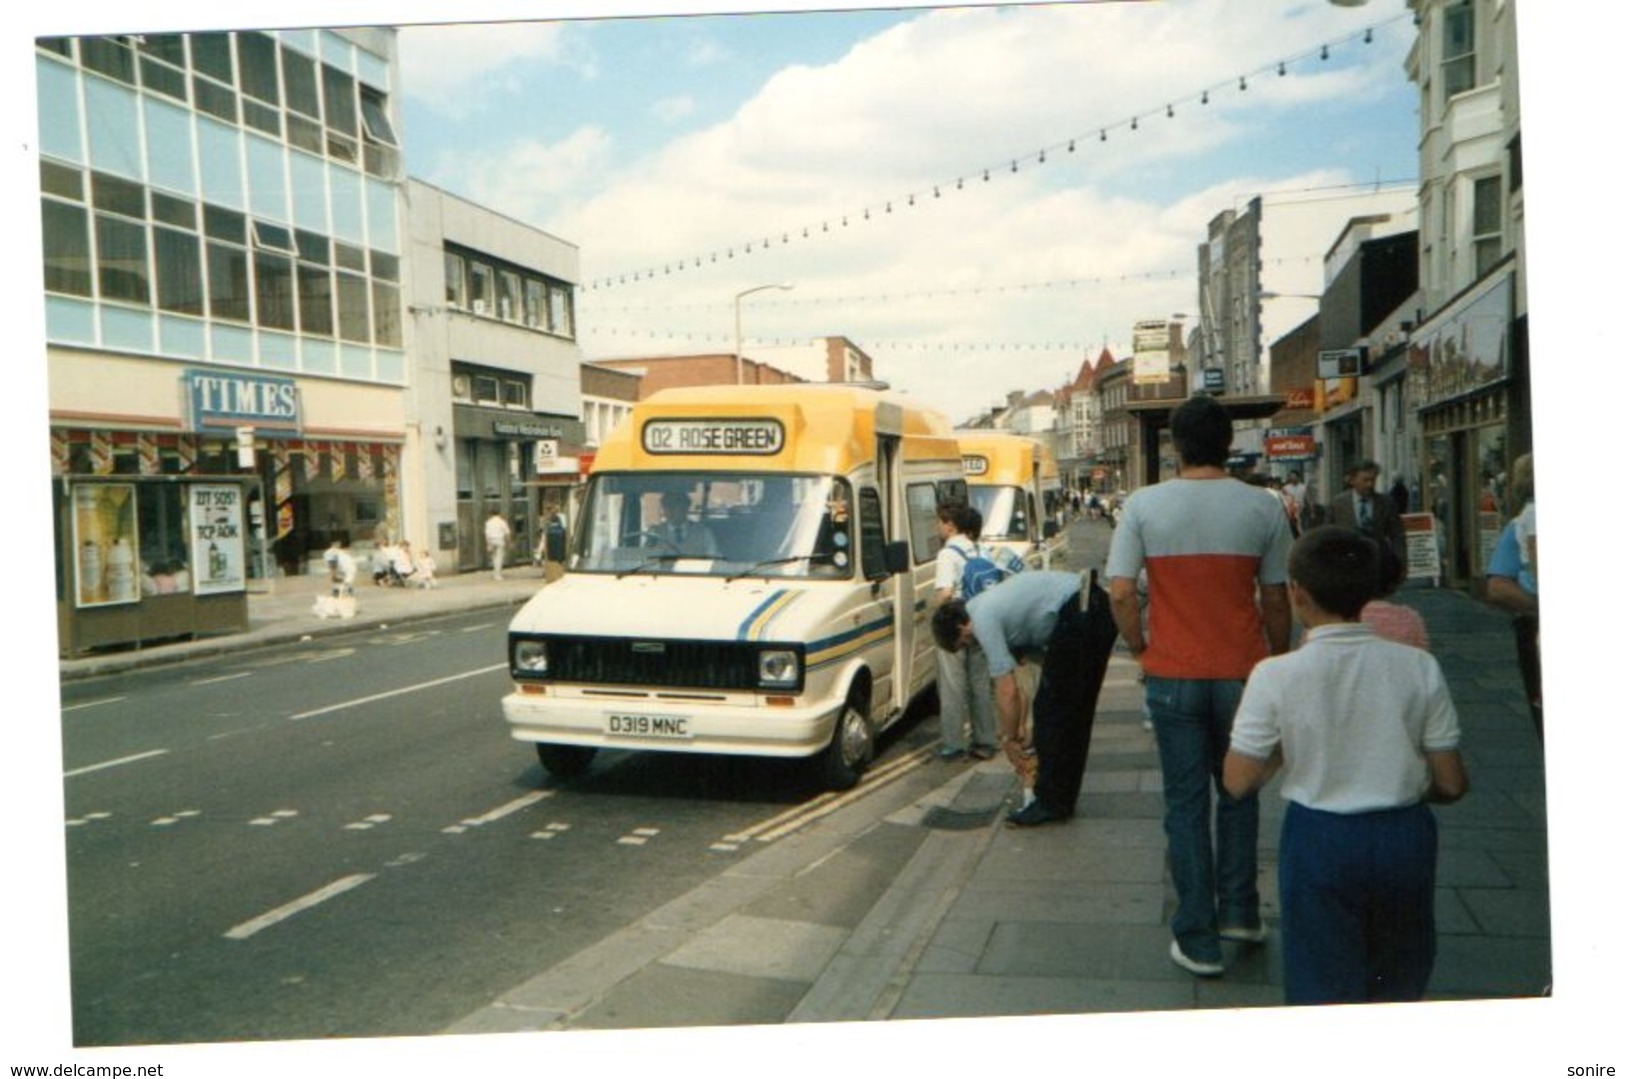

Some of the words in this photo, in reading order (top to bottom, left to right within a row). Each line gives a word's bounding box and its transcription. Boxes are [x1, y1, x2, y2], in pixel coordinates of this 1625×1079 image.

[194, 376, 295, 417] TIMES
[679, 427, 721, 448] ROSE
[723, 427, 775, 449] GREEN
[609, 716, 649, 733] D319
[652, 718, 687, 735] MNC
